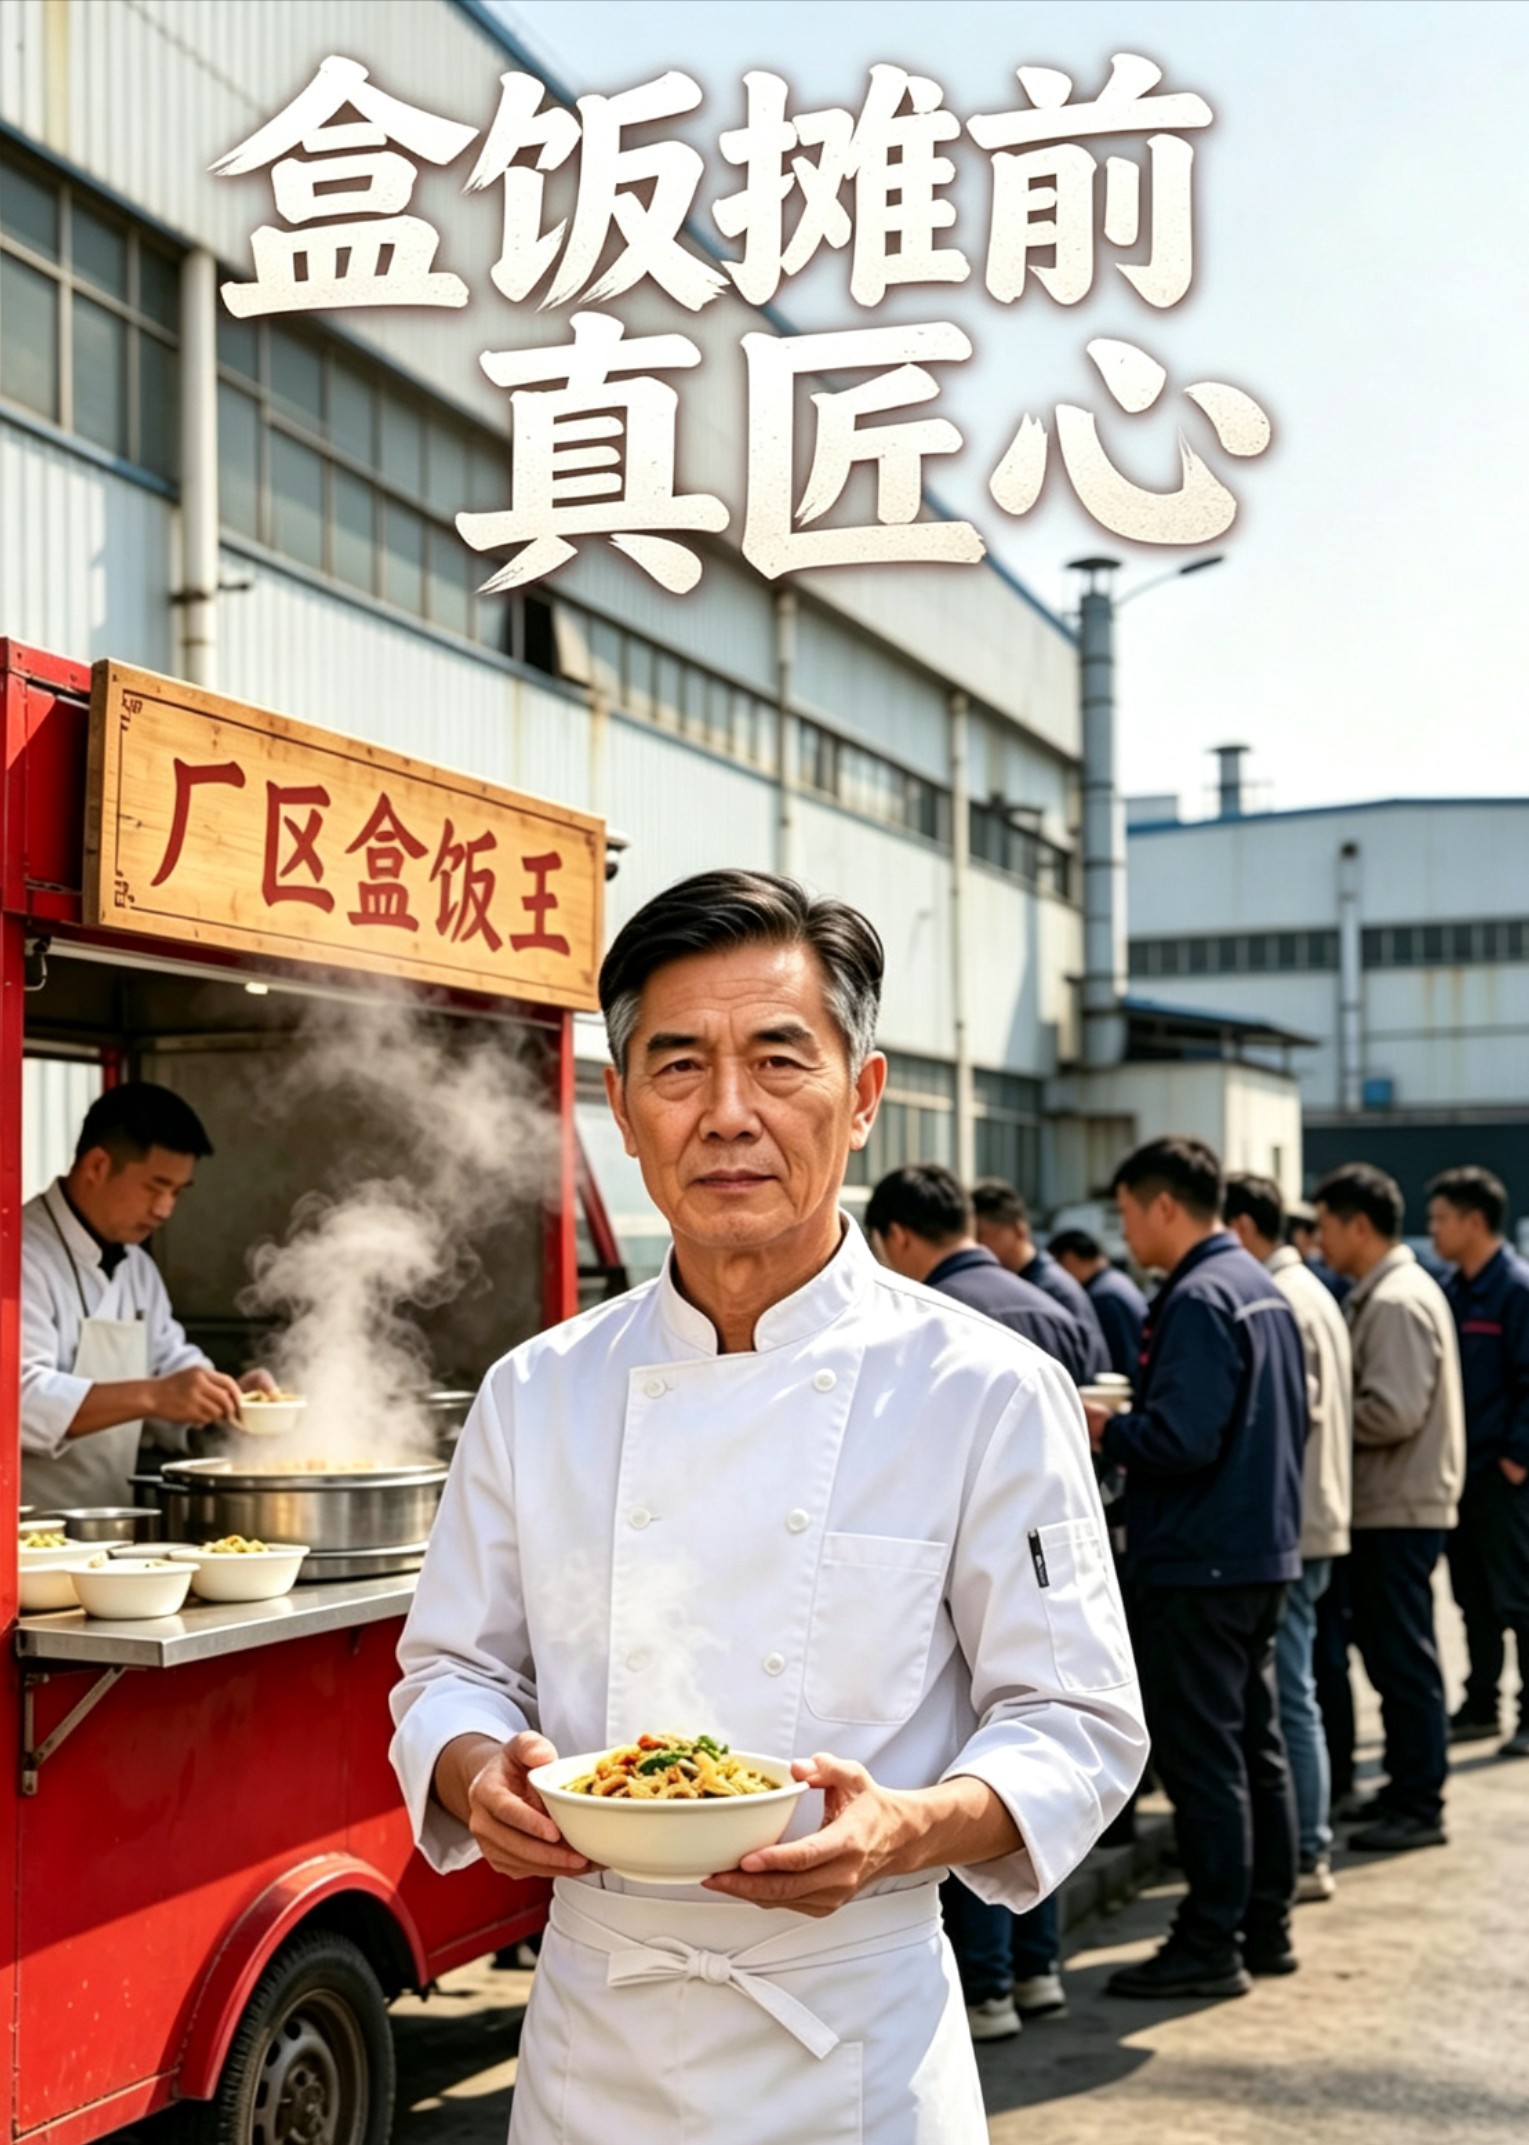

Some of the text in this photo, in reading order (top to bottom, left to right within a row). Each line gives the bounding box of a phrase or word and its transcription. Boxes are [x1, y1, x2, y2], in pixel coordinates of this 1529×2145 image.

[151, 758, 570, 955] 厂区盒饭王
